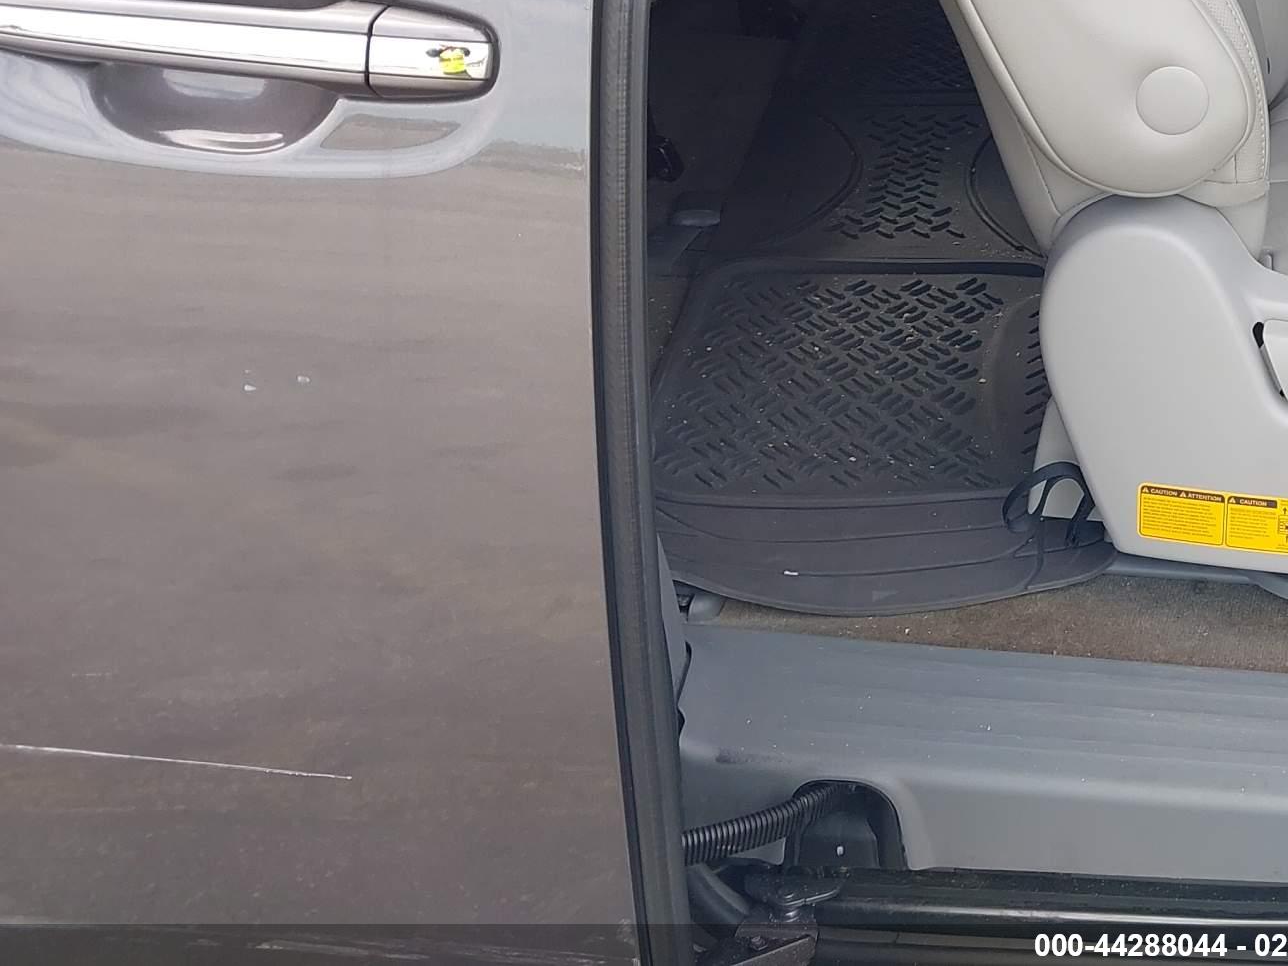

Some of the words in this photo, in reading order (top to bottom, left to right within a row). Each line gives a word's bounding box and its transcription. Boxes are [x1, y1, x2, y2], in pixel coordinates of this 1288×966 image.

[1150, 488, 1178, 497] CAUTION
[1187, 493, 1222, 502] ATTENTION
[1239, 498, 1268, 507] CAUTION
